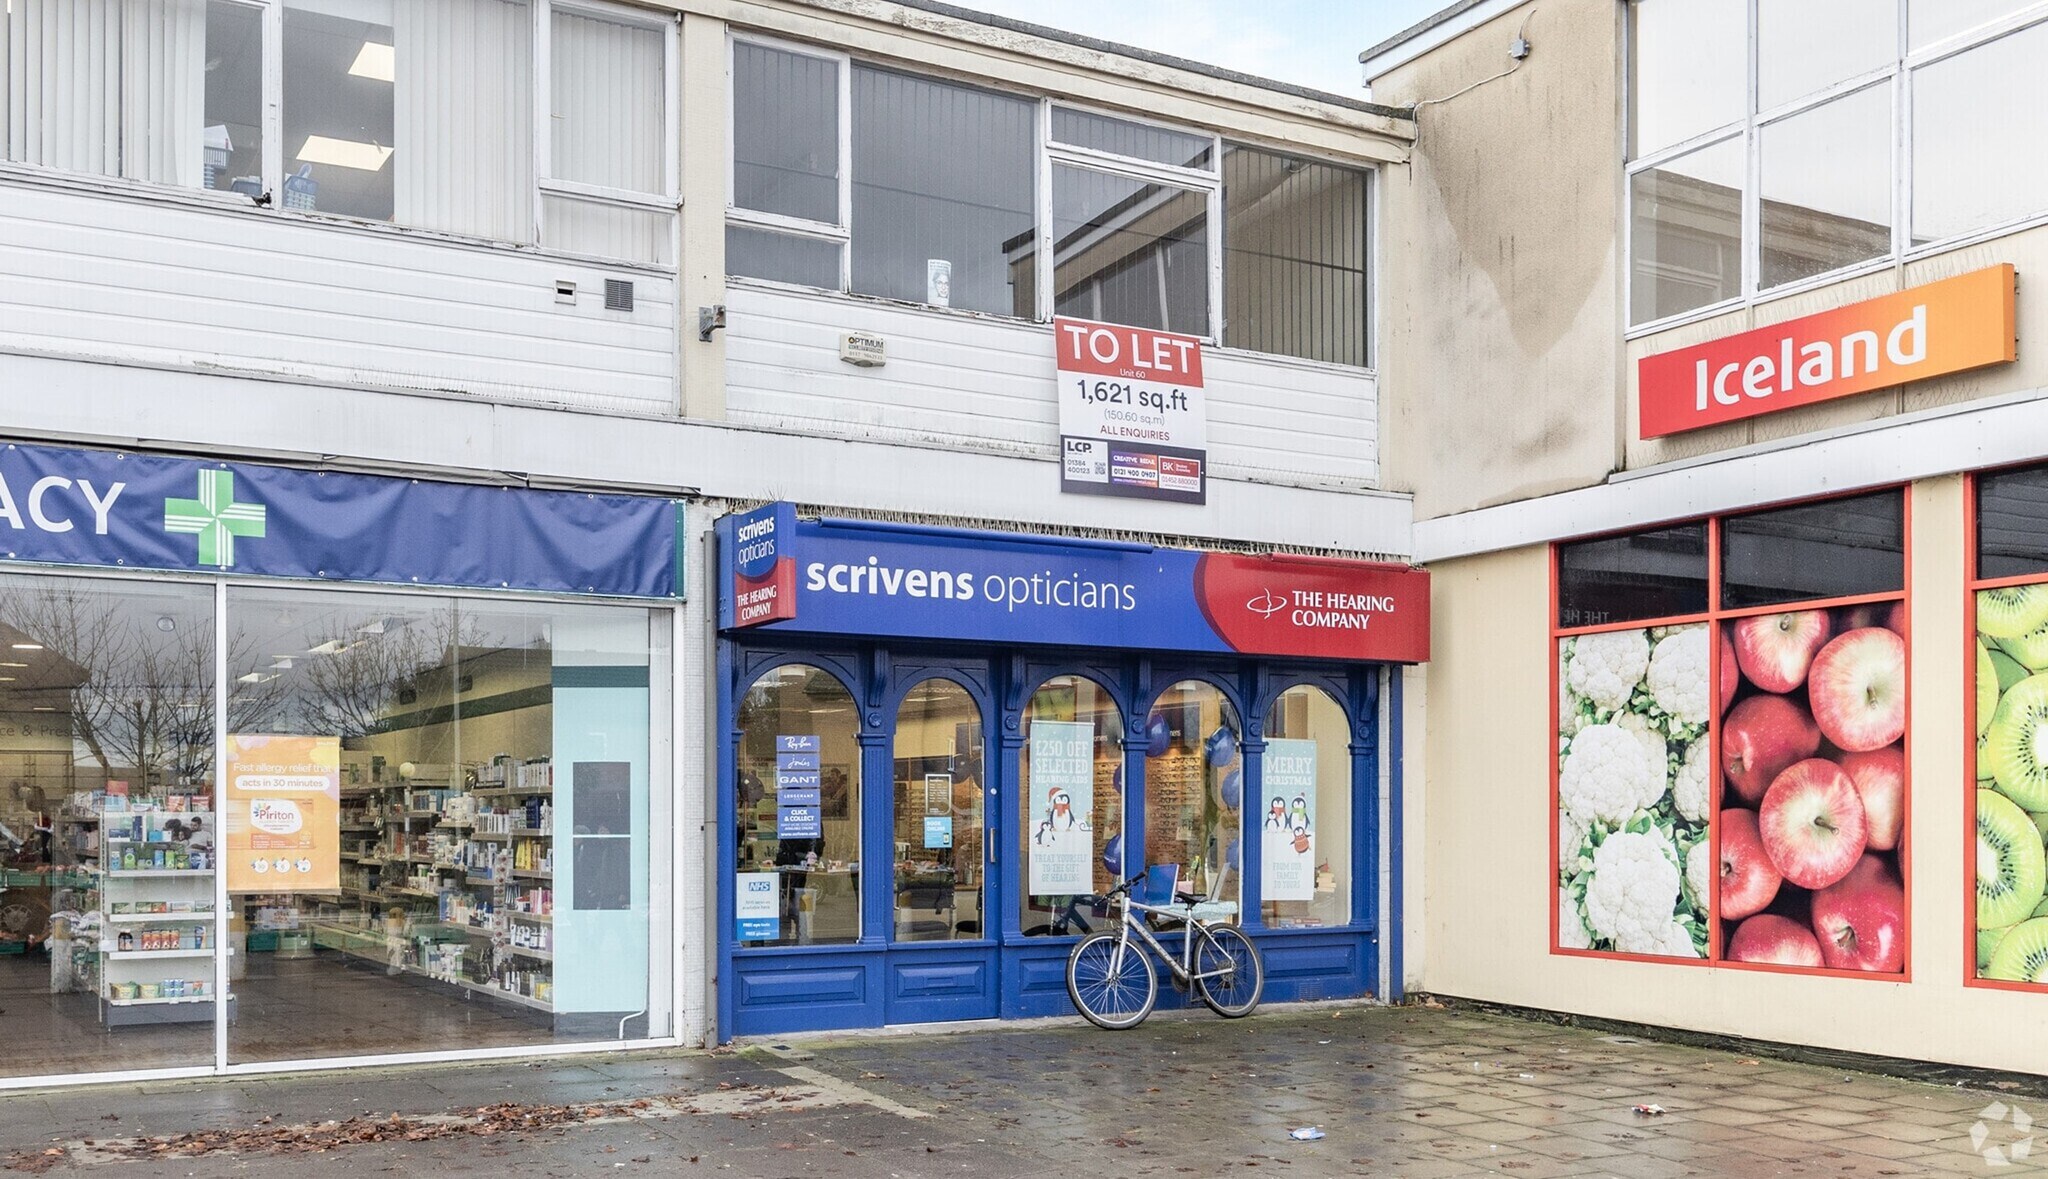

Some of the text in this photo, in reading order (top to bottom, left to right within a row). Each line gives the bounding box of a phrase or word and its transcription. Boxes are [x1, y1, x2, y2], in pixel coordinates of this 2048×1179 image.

[848, 336, 884, 349] OPTIMUM
[1063, 324, 1195, 374] TO LET
[1695, 304, 1927, 411] Iceland
[1120, 368, 1146, 379] Unit 60
[1077, 379, 1188, 414] 1,621 sq.ft
[1104, 408, 1165, 426] (150.60 sq.m)
[1100, 425, 1170, 441] ALL ENQUIRIES
[1113, 468, 1126, 476] 0121
[1127, 469, 1140, 477] 400
[1162, 461, 1175, 472] BK
[738, 516, 775, 543] scrivens
[738, 539, 775, 568] opticians
[806, 556, 1136, 613] scrivens opticians
[737, 584, 777, 607] THE HEARING
[1292, 590, 1395, 613] THE HEARING
[741, 601, 772, 620] COMPANY
[1291, 609, 1370, 629] COMPANY
[22, 724, 33, 737] &
[1036, 740, 1089, 757] £250 OFF
[233, 763, 254, 773] Fast
[256, 763, 288, 774] allergy
[289, 763, 312, 773] relief
[1036, 758, 1088, 774] SELECTED
[1266, 756, 1312, 774] MERRY
[242, 779, 323, 787] acts in 30 minutes
[779, 776, 818, 784] GANT
[1036, 775, 1070, 784] HEARING
[1265, 775, 1312, 786] CHRISTMAS
[259, 809, 294, 820] Piriton
[750, 882, 770, 891] NHS
